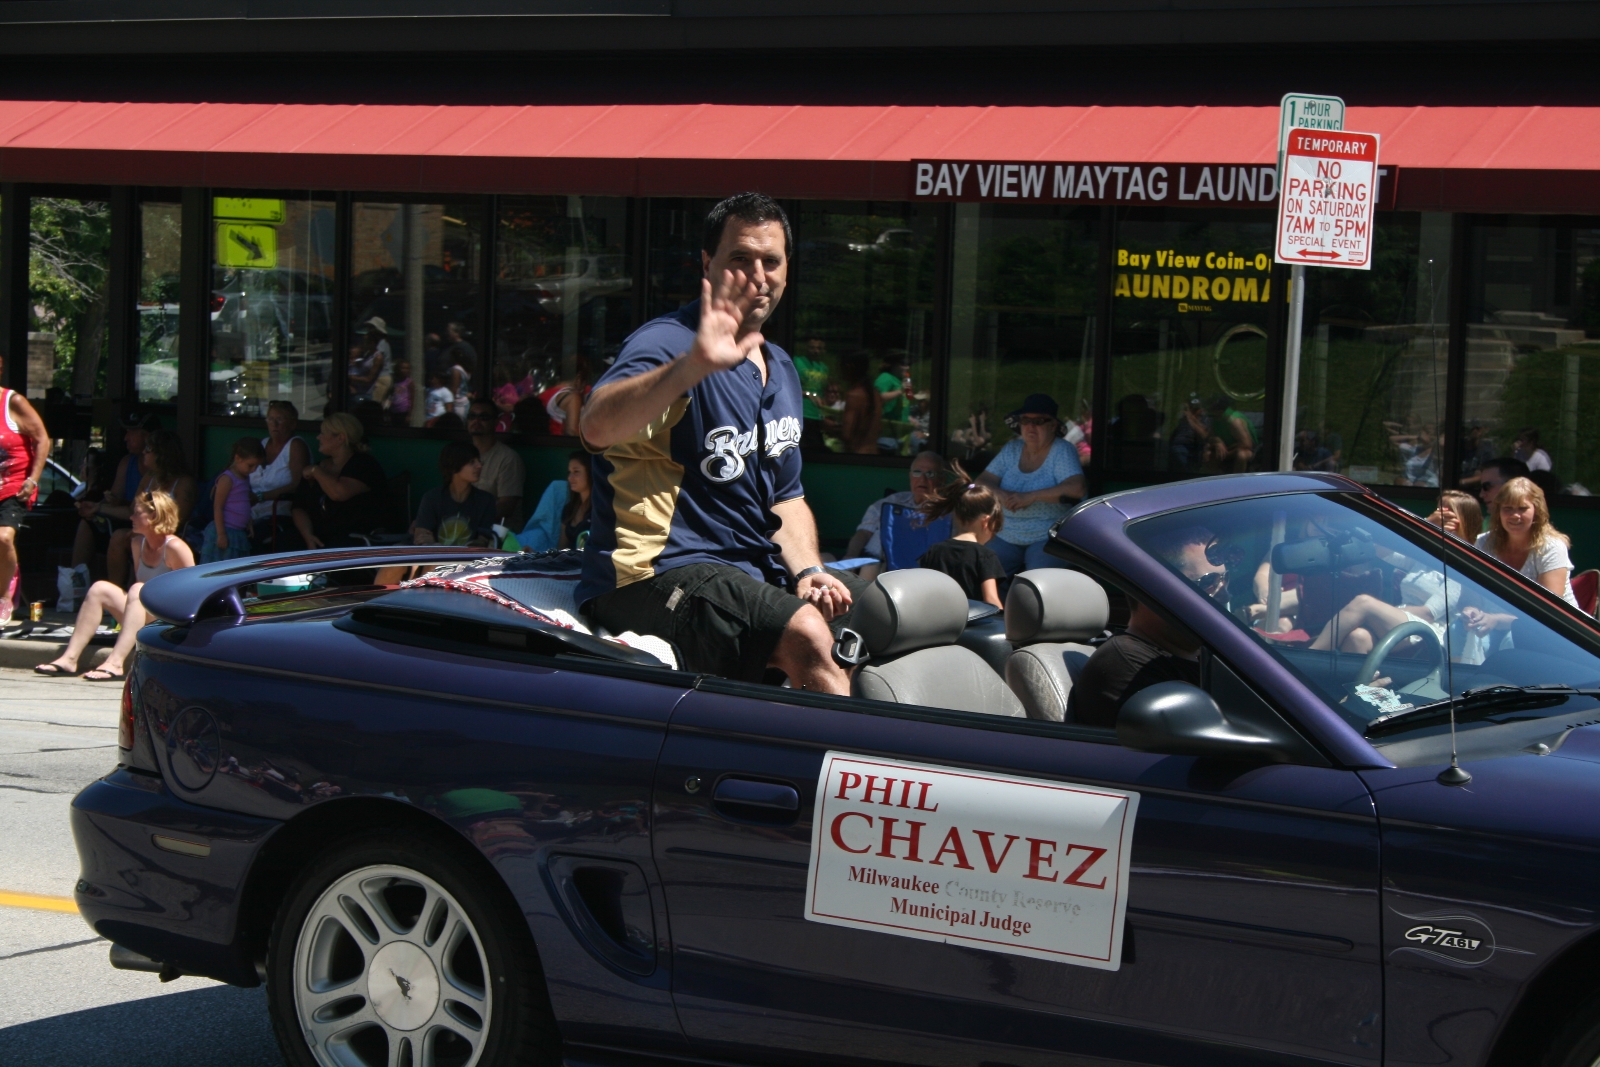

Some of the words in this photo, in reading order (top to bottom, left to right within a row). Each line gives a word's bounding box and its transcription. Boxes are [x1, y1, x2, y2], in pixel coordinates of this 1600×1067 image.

[1290, 101, 1296, 127] 1
[1303, 101, 1331, 117] HOUR
[1298, 117, 1340, 131] PARKING
[1297, 136, 1368, 155] TEMPORARY
[1317, 160, 1342, 179] NO
[915, 163, 970, 196] BAY
[976, 164, 1047, 198] VIEW
[1052, 165, 1168, 201] MAYTAG
[1288, 178, 1367, 201] PARKING
[1286, 198, 1303, 214] ON
[1309, 200, 1367, 219] SATURDAY
[1285, 215, 1315, 234] 7AM
[1319, 221, 1331, 232] TO
[1334, 219, 1366, 238] 5PM
[1287, 235, 1325, 247] SPECIAL
[1332, 238, 1362, 250] EVENT
[1117, 249, 1151, 270] Bay
[1156, 250, 1200, 269] View
[1205, 251, 1271, 273] Coin-O
[1115, 273, 1271, 303] AUNDROMA
[834, 771, 939, 812] PHIL
[830, 811, 1108, 890] CHAVEZ
[847, 865, 939, 894] Milwaukee
[945, 879, 1008, 908] County
[1012, 890, 1081, 917] Reserve
[890, 896, 976, 926] Municipal
[980, 910, 1032, 937] Judge
